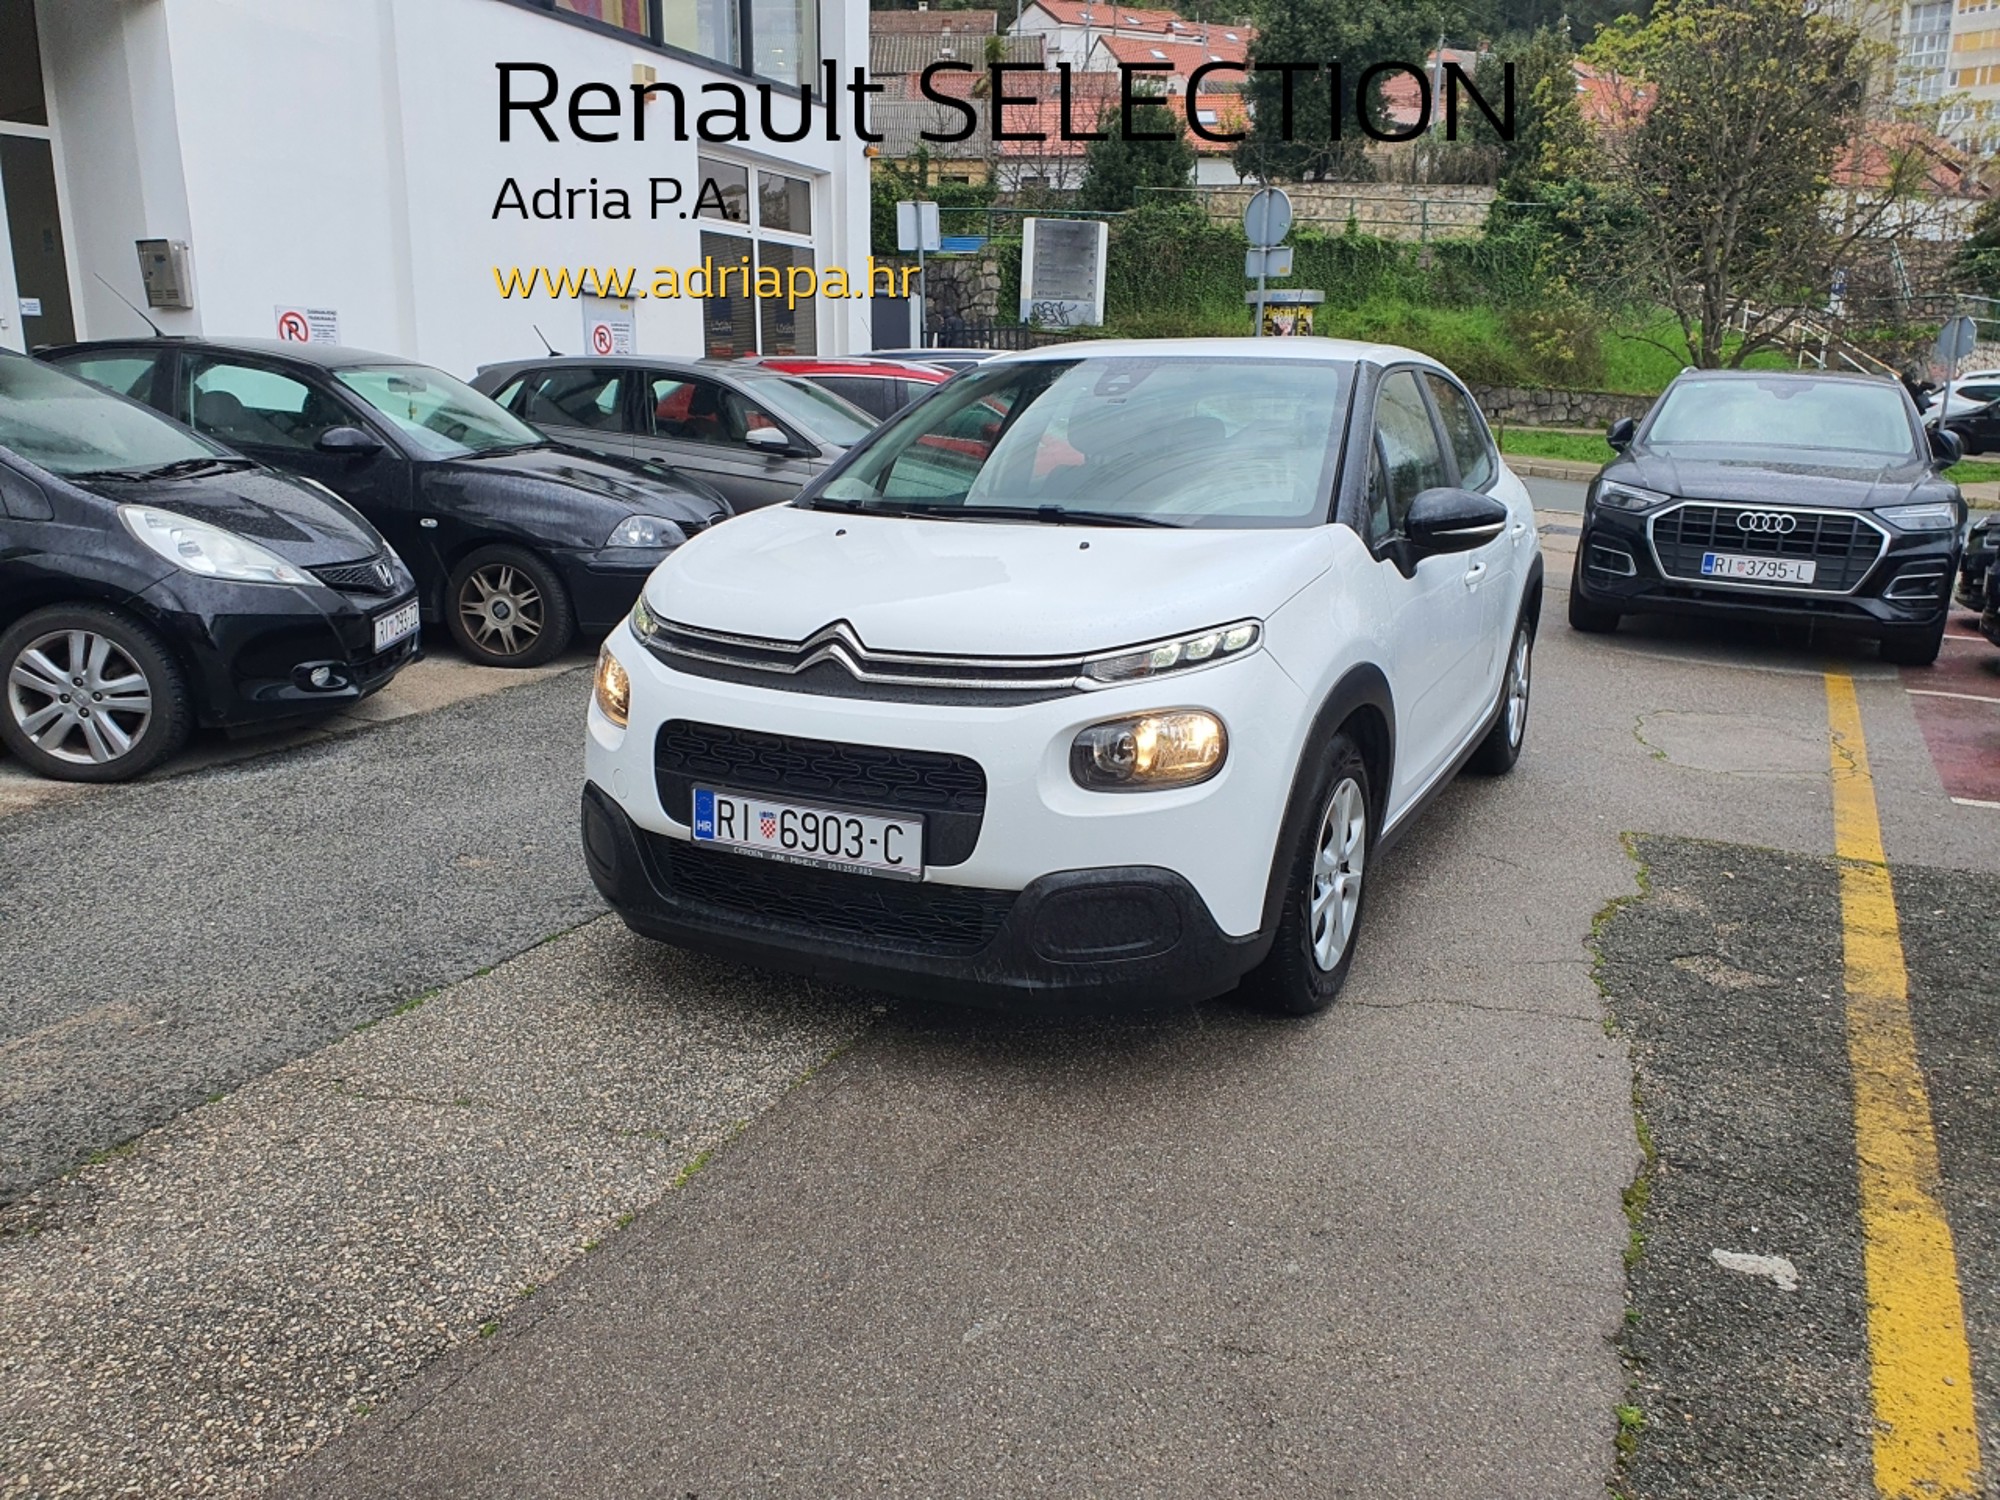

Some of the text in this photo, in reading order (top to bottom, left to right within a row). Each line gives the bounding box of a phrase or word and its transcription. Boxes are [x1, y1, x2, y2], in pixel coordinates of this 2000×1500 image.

[1714, 557, 1804, 580] RI 3795-L
[697, 820, 712, 832] HR
[717, 798, 904, 865] RI 6903-C
